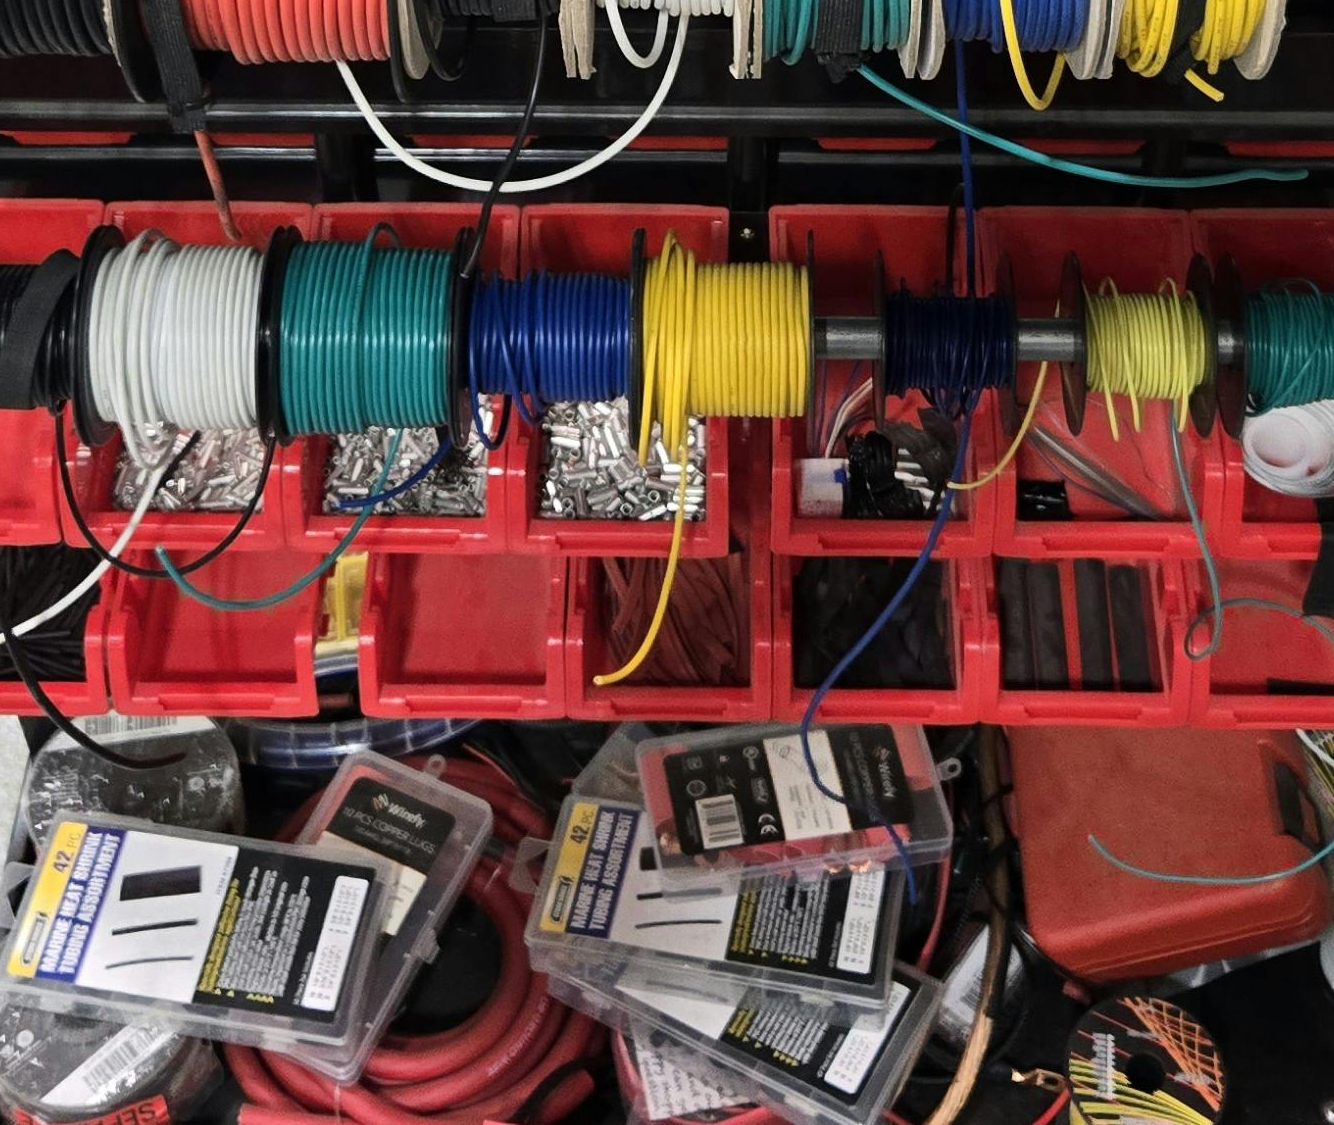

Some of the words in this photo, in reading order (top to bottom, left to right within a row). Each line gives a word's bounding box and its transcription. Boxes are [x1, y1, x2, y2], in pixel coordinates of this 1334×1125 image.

[569, 824, 590, 845] 42
[592, 810, 615, 851] SHRINK
[51, 848, 74, 875] 42
[584, 852, 604, 882] HEAT
[589, 887, 614, 930] TUBING
[602, 812, 634, 887] ASSORTMENT
[39, 916, 71, 972] MARINE
[59, 881, 84, 917] HEAT
[72, 831, 103, 881] SHRINK
[58, 921, 90, 973] TUBING
[76, 833, 121, 924] ASSORTMENT
[570, 882, 596, 929] MARINE
